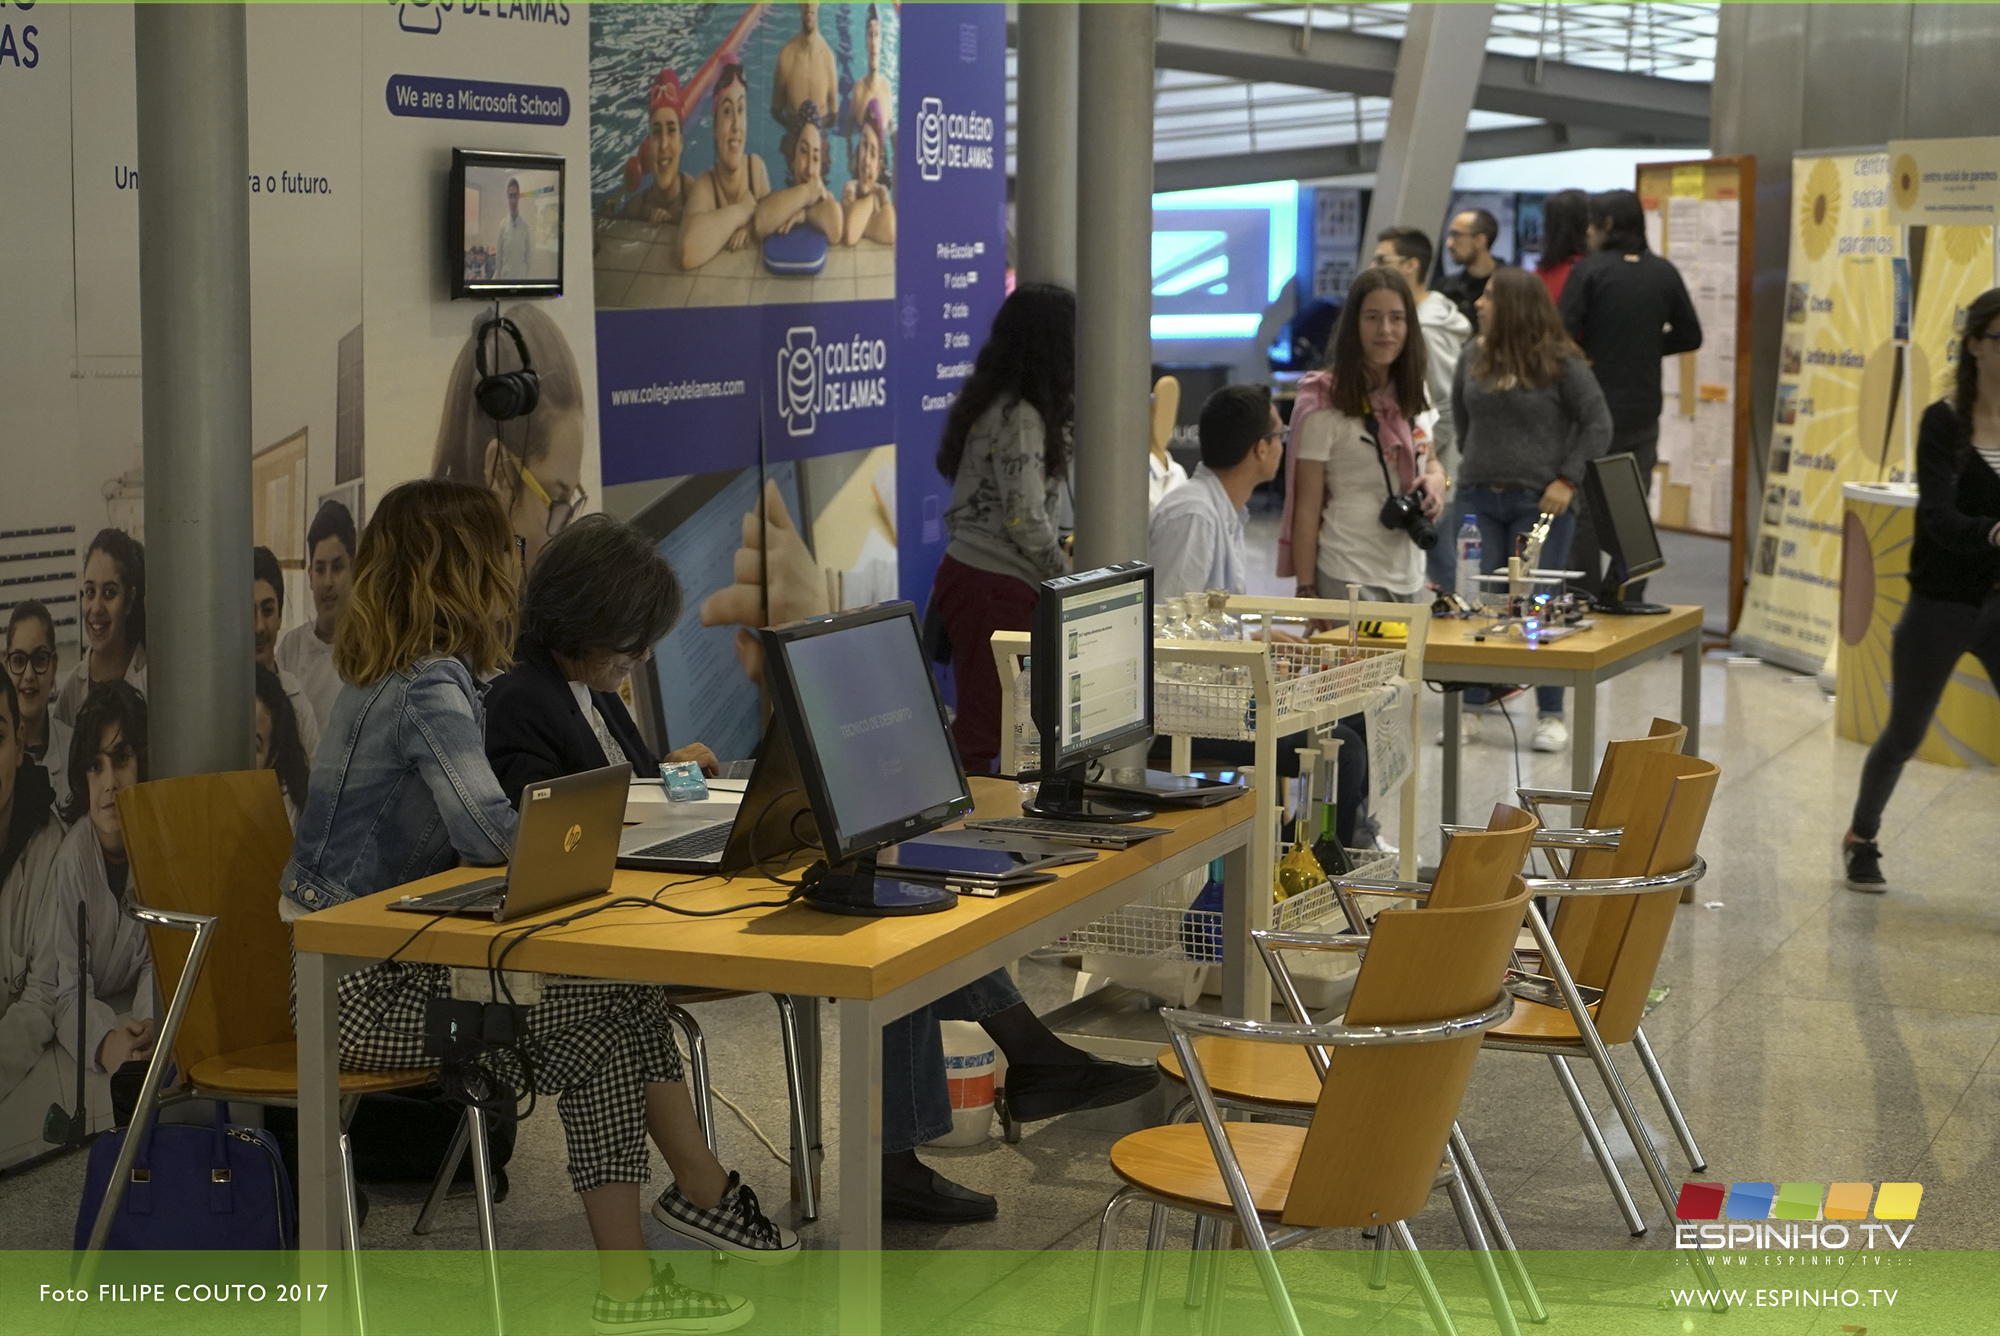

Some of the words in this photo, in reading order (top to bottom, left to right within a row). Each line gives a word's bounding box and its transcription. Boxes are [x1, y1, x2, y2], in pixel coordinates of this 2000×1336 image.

[396, 85, 418, 107] We
[421, 91, 443, 109] are
[447, 94, 455, 109] a
[458, 90, 517, 114] Microsoft
[520, 94, 562, 117] School
[947, 109, 994, 141] COLÉGIO
[947, 144, 961, 168] DE
[961, 145, 994, 170] LAMAS
[266, 176, 276, 193] o
[281, 170, 332, 194] futuro.
[825, 334, 886, 375] COLÉGIO
[612, 379, 745, 405] www.colegiodelamas.com
[825, 382, 841, 413] DE
[842, 377, 886, 411] LAMAS
[565, 825, 581, 852] hp
